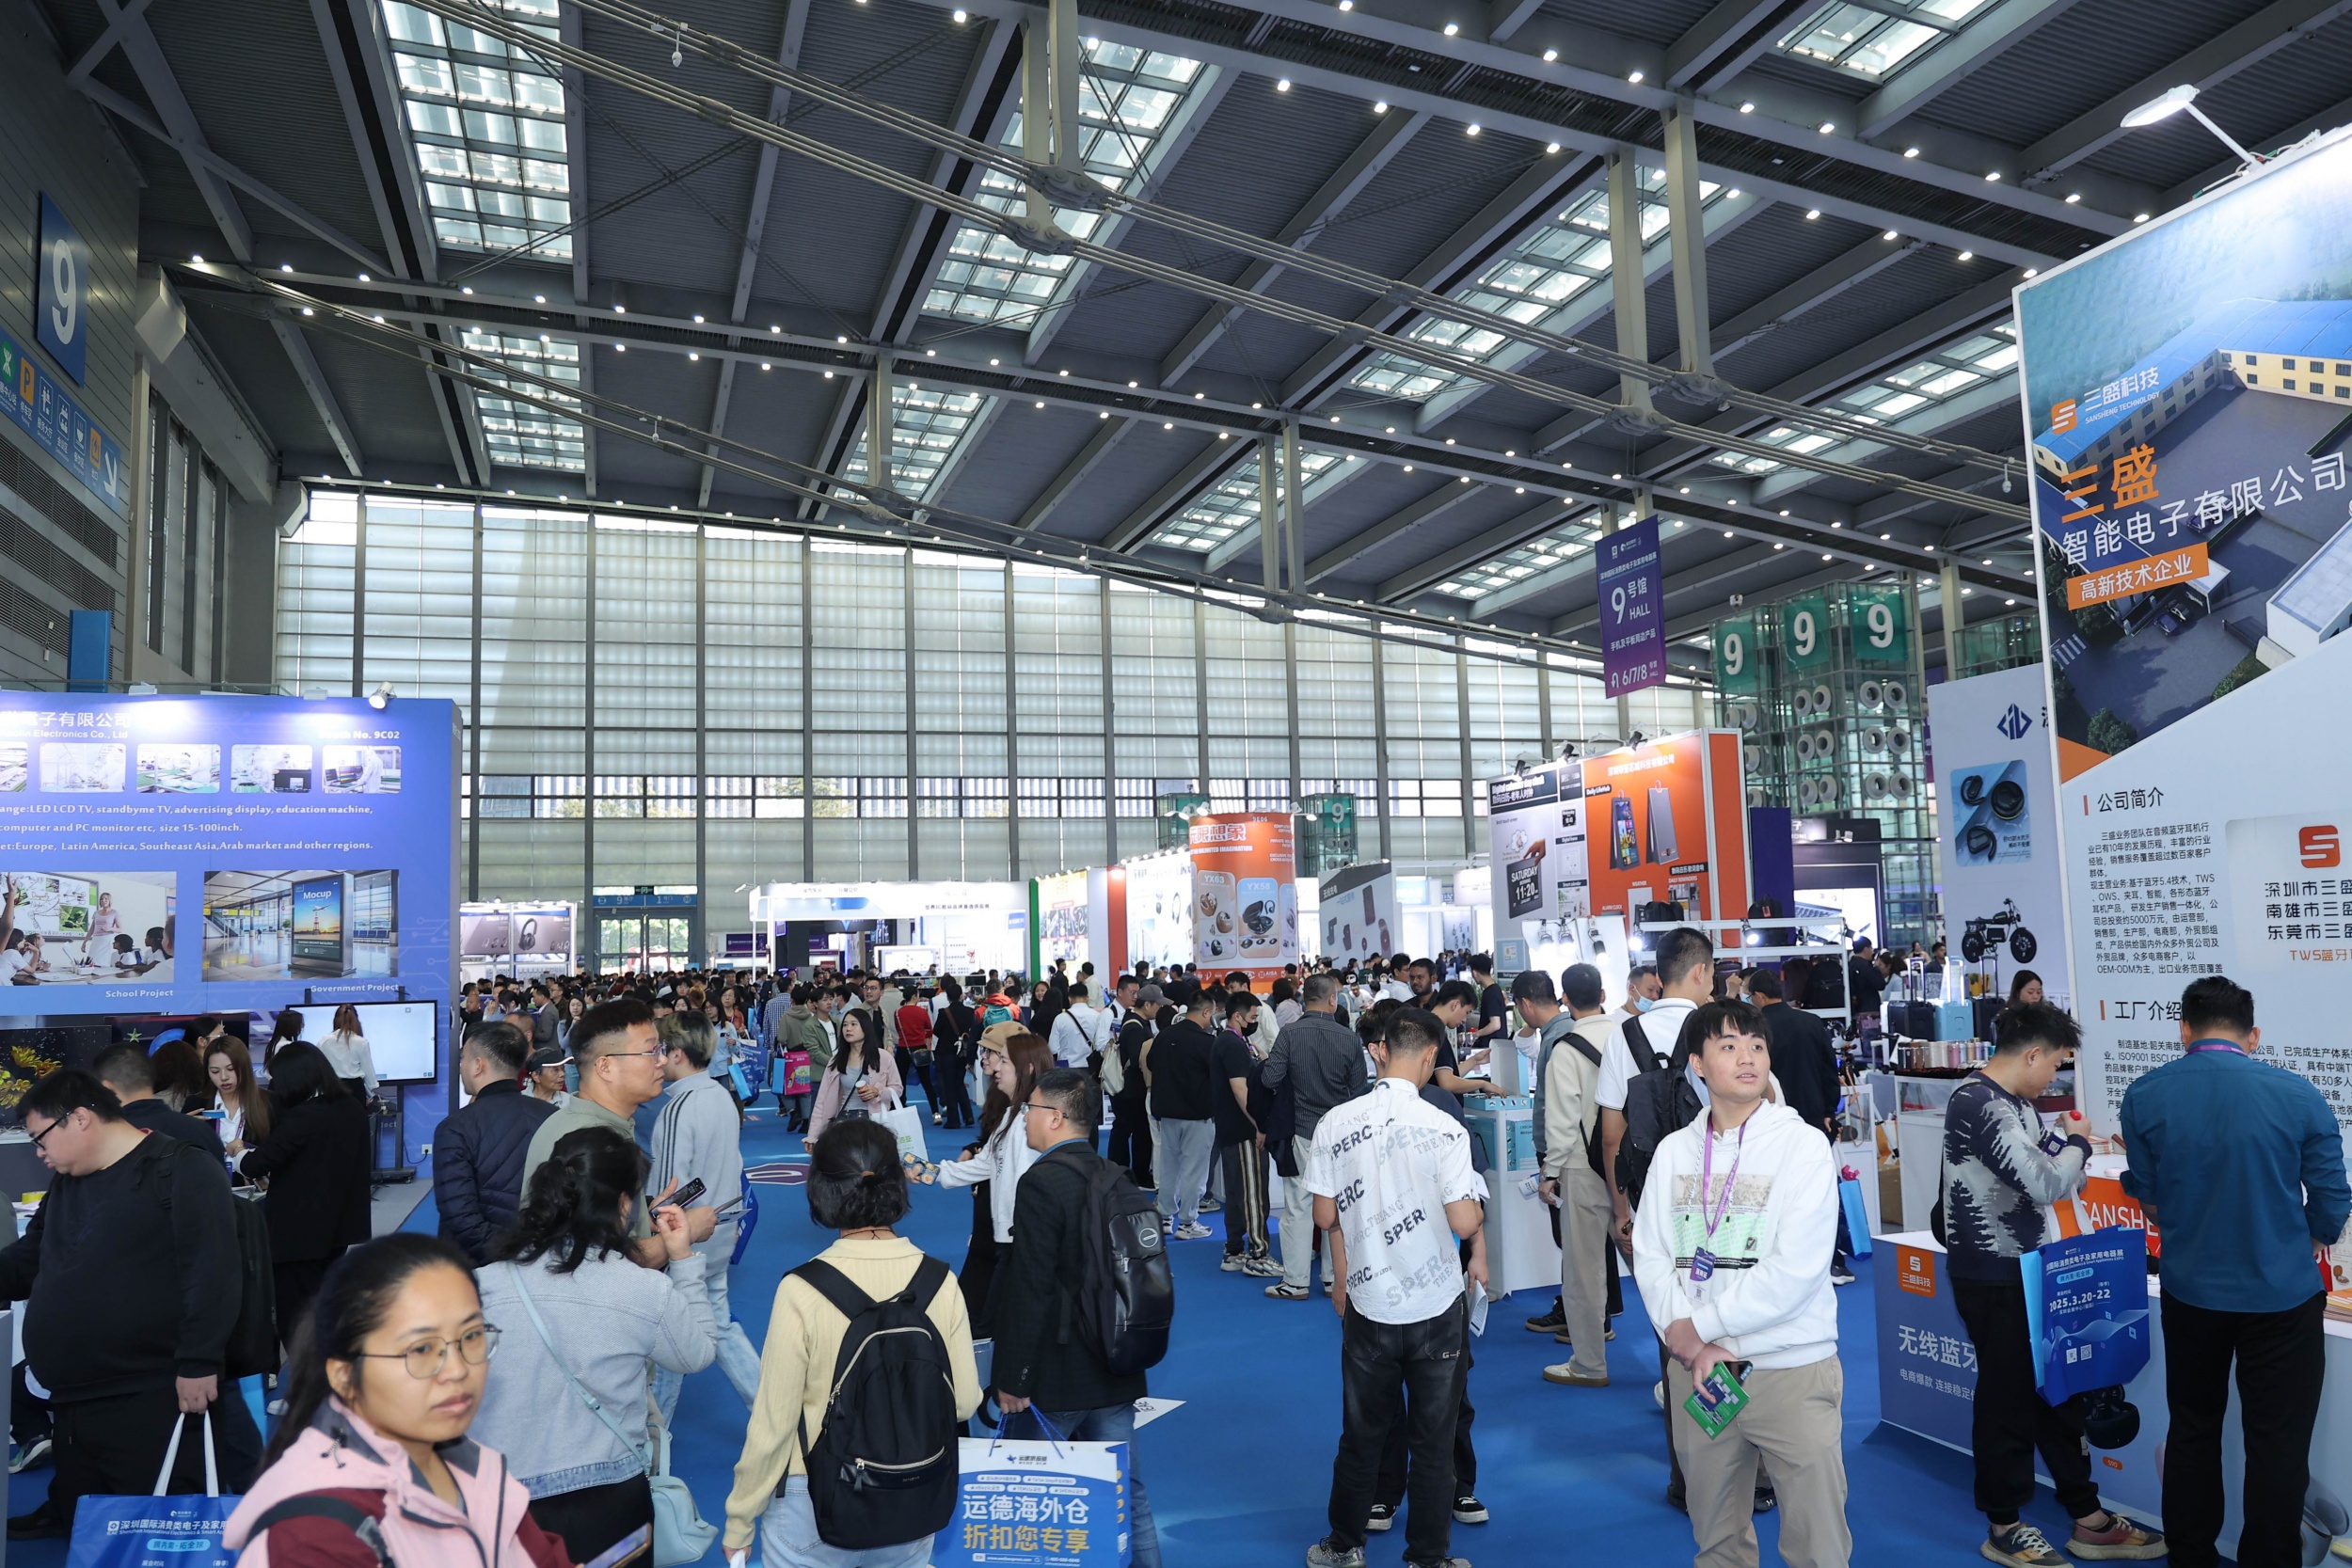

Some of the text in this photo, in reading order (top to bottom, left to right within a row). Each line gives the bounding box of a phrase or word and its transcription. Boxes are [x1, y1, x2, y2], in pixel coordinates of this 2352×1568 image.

[52, 239, 76, 345] 9
[2084, 367, 2160, 412] 三盛科技
[2085, 390, 2160, 424] SANSHENG TECHNOLOGY
[2060, 443, 2160, 524] 三盛
[2062, 451, 2346, 565] 智能电子有限公司
[1628, 577, 1647, 599] 号馆
[2079, 553, 2194, 602] 高新技术企业
[1611, 587, 1626, 625] 9
[1629, 607, 1651, 621] HALL
[1793, 611, 1816, 656] 9
[1867, 603, 1895, 648] 9
[1610, 628, 1656, 651] 手机及平板周边产品
[1724, 633, 1743, 676] 9
[1622, 664, 1647, 686] 6/7/8
[0, 710, 131, 728] 電子有限公司
[33, 730, 129, 739] Electronics Co., Ltd
[353, 731, 372, 739] No.
[373, 731, 400, 739] 9C02
[53, 804, 76, 814] LCD
[96, 805, 155, 816] standbyme
[234, 805, 275, 816] display,
[276, 805, 326, 814] education
[328, 805, 373, 816] machine,
[2097, 786, 2164, 813] 公司简介
[1331, 802, 1344, 823] 9
[53, 823, 73, 832] and
[75, 823, 90, 832] PC
[91, 823, 135, 832] monitor
[136, 824, 156, 834] etc,
[159, 823, 180, 832] size
[182, 823, 243, 832] 15-100inch.
[2101, 822, 2209, 841] 三盛业务团队在音频蓝牙耳机行
[61, 842, 89, 850] Latin
[90, 842, 138, 852] America,
[139, 841, 193, 850] Southeast
[246, 841, 282, 849] market
[284, 841, 303, 849] and
[304, 841, 332, 849] other
[333, 841, 373, 852] regions.
[1204, 875, 1225, 883] YX63
[1511, 865, 1539, 882] SATURDAY
[303, 890, 332, 900] Mocup
[1247, 882, 1271, 891] YX58
[1516, 882, 1535, 900] 11:20
[2265, 879, 2352, 897] 深圳市三盛
[2266, 901, 2352, 919] 南雄市三盛
[2289, 948, 2352, 961] TWS蓝牙
[105, 990, 174, 998] School Project
[367, 984, 400, 992] Project
[2115, 1000, 2183, 1022] 工厂介绍
[2250, 1045, 2352, 1059] 公司，已完成生产体系
[1333, 1177, 1365, 1214] ERC
[1384, 1202, 1427, 1247] SPER
[1385, 1251, 1446, 1308] SPER
[1901, 1272, 1931, 1288] 三盛科技
[2050, 1289, 2111, 1313] 2025.3.20-22
[1899, 1324, 1979, 1373] 无线蓝牙
[1899, 1368, 1934, 1389] 电商爆款
[962, 1495, 1089, 1525] 运德海外仓
[962, 1523, 1090, 1554] 折扣您专享
